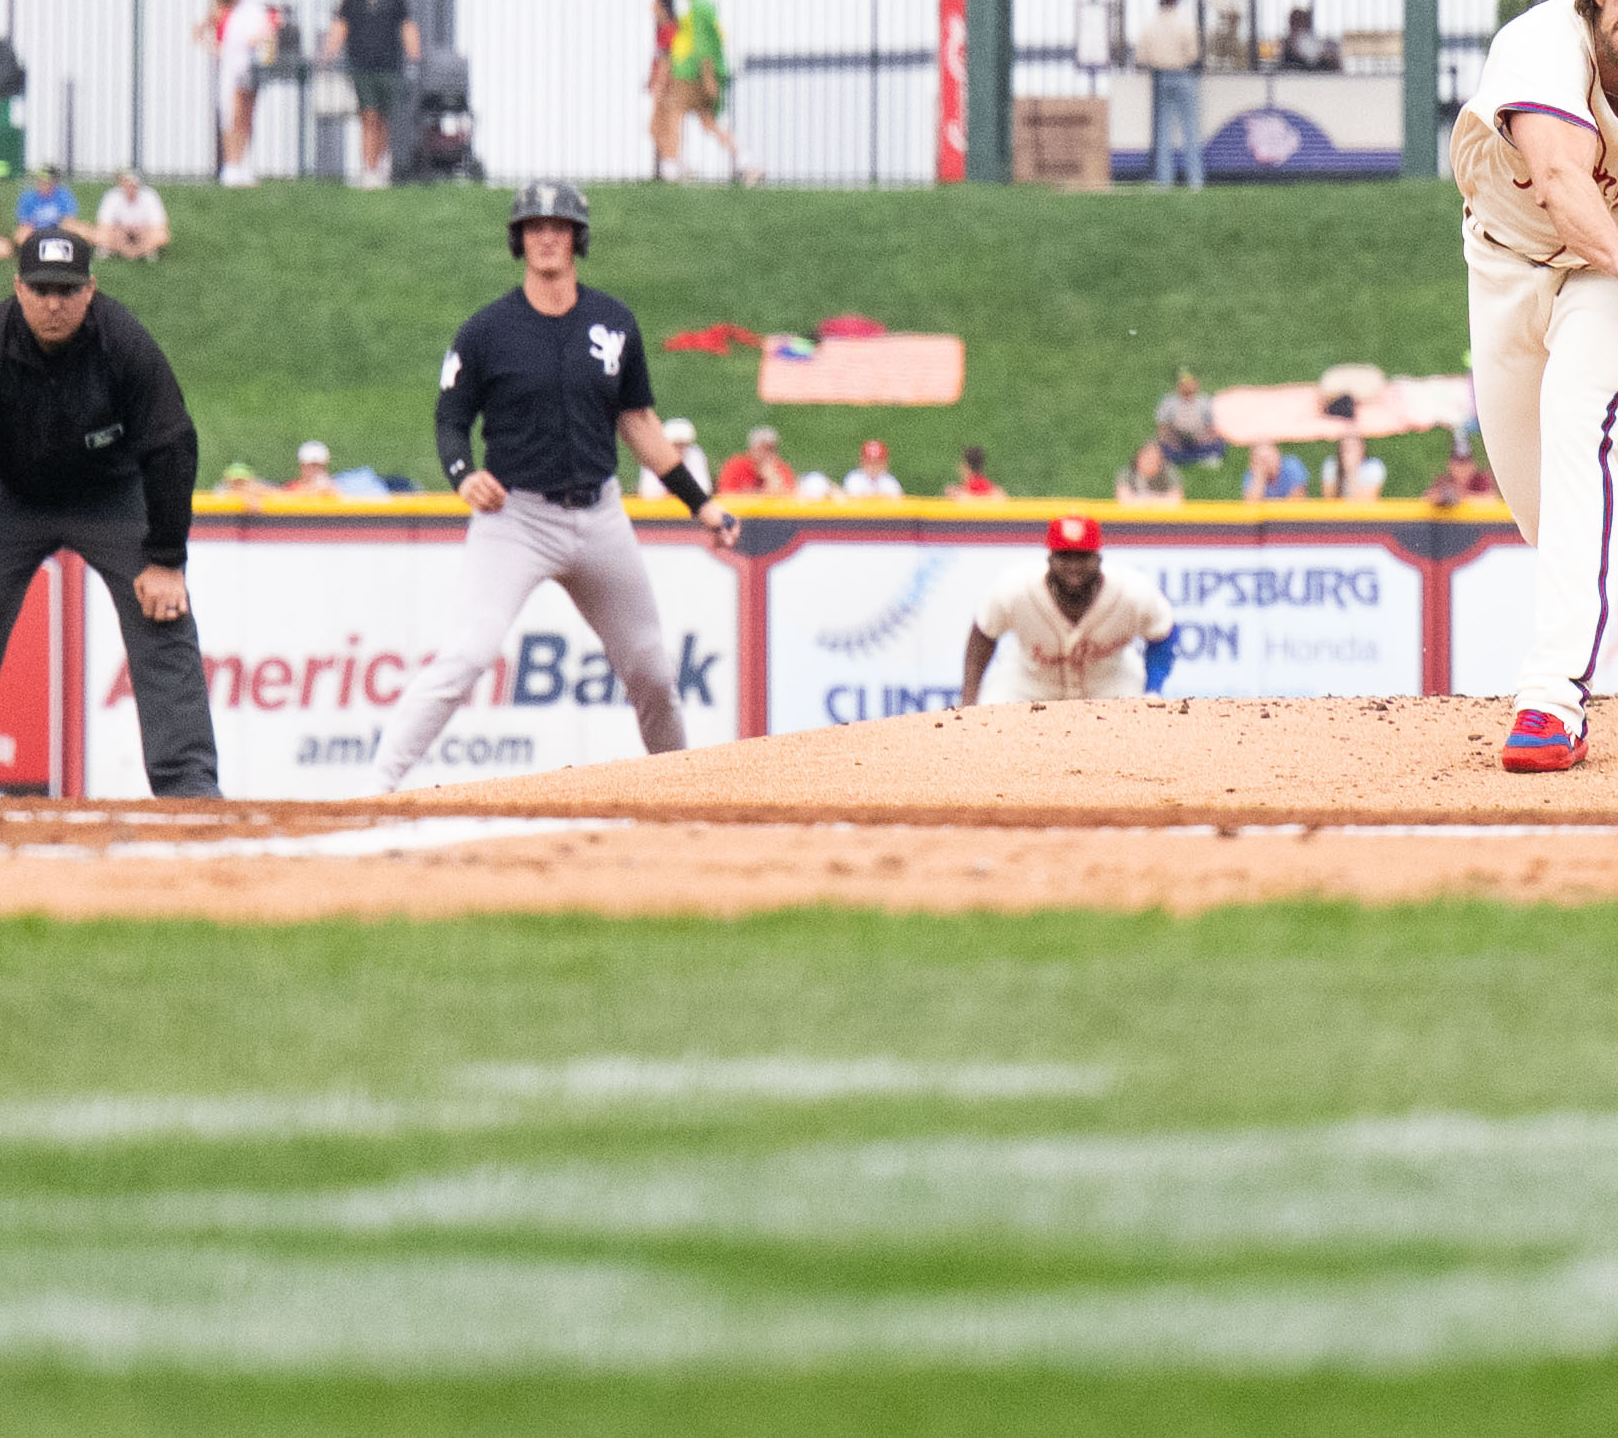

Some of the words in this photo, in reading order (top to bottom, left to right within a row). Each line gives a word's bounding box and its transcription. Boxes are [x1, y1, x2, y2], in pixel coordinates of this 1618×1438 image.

[104, 631, 720, 710] mericnBak
[824, 684, 964, 725] CLINT
[295, 731, 535, 768] am.com
